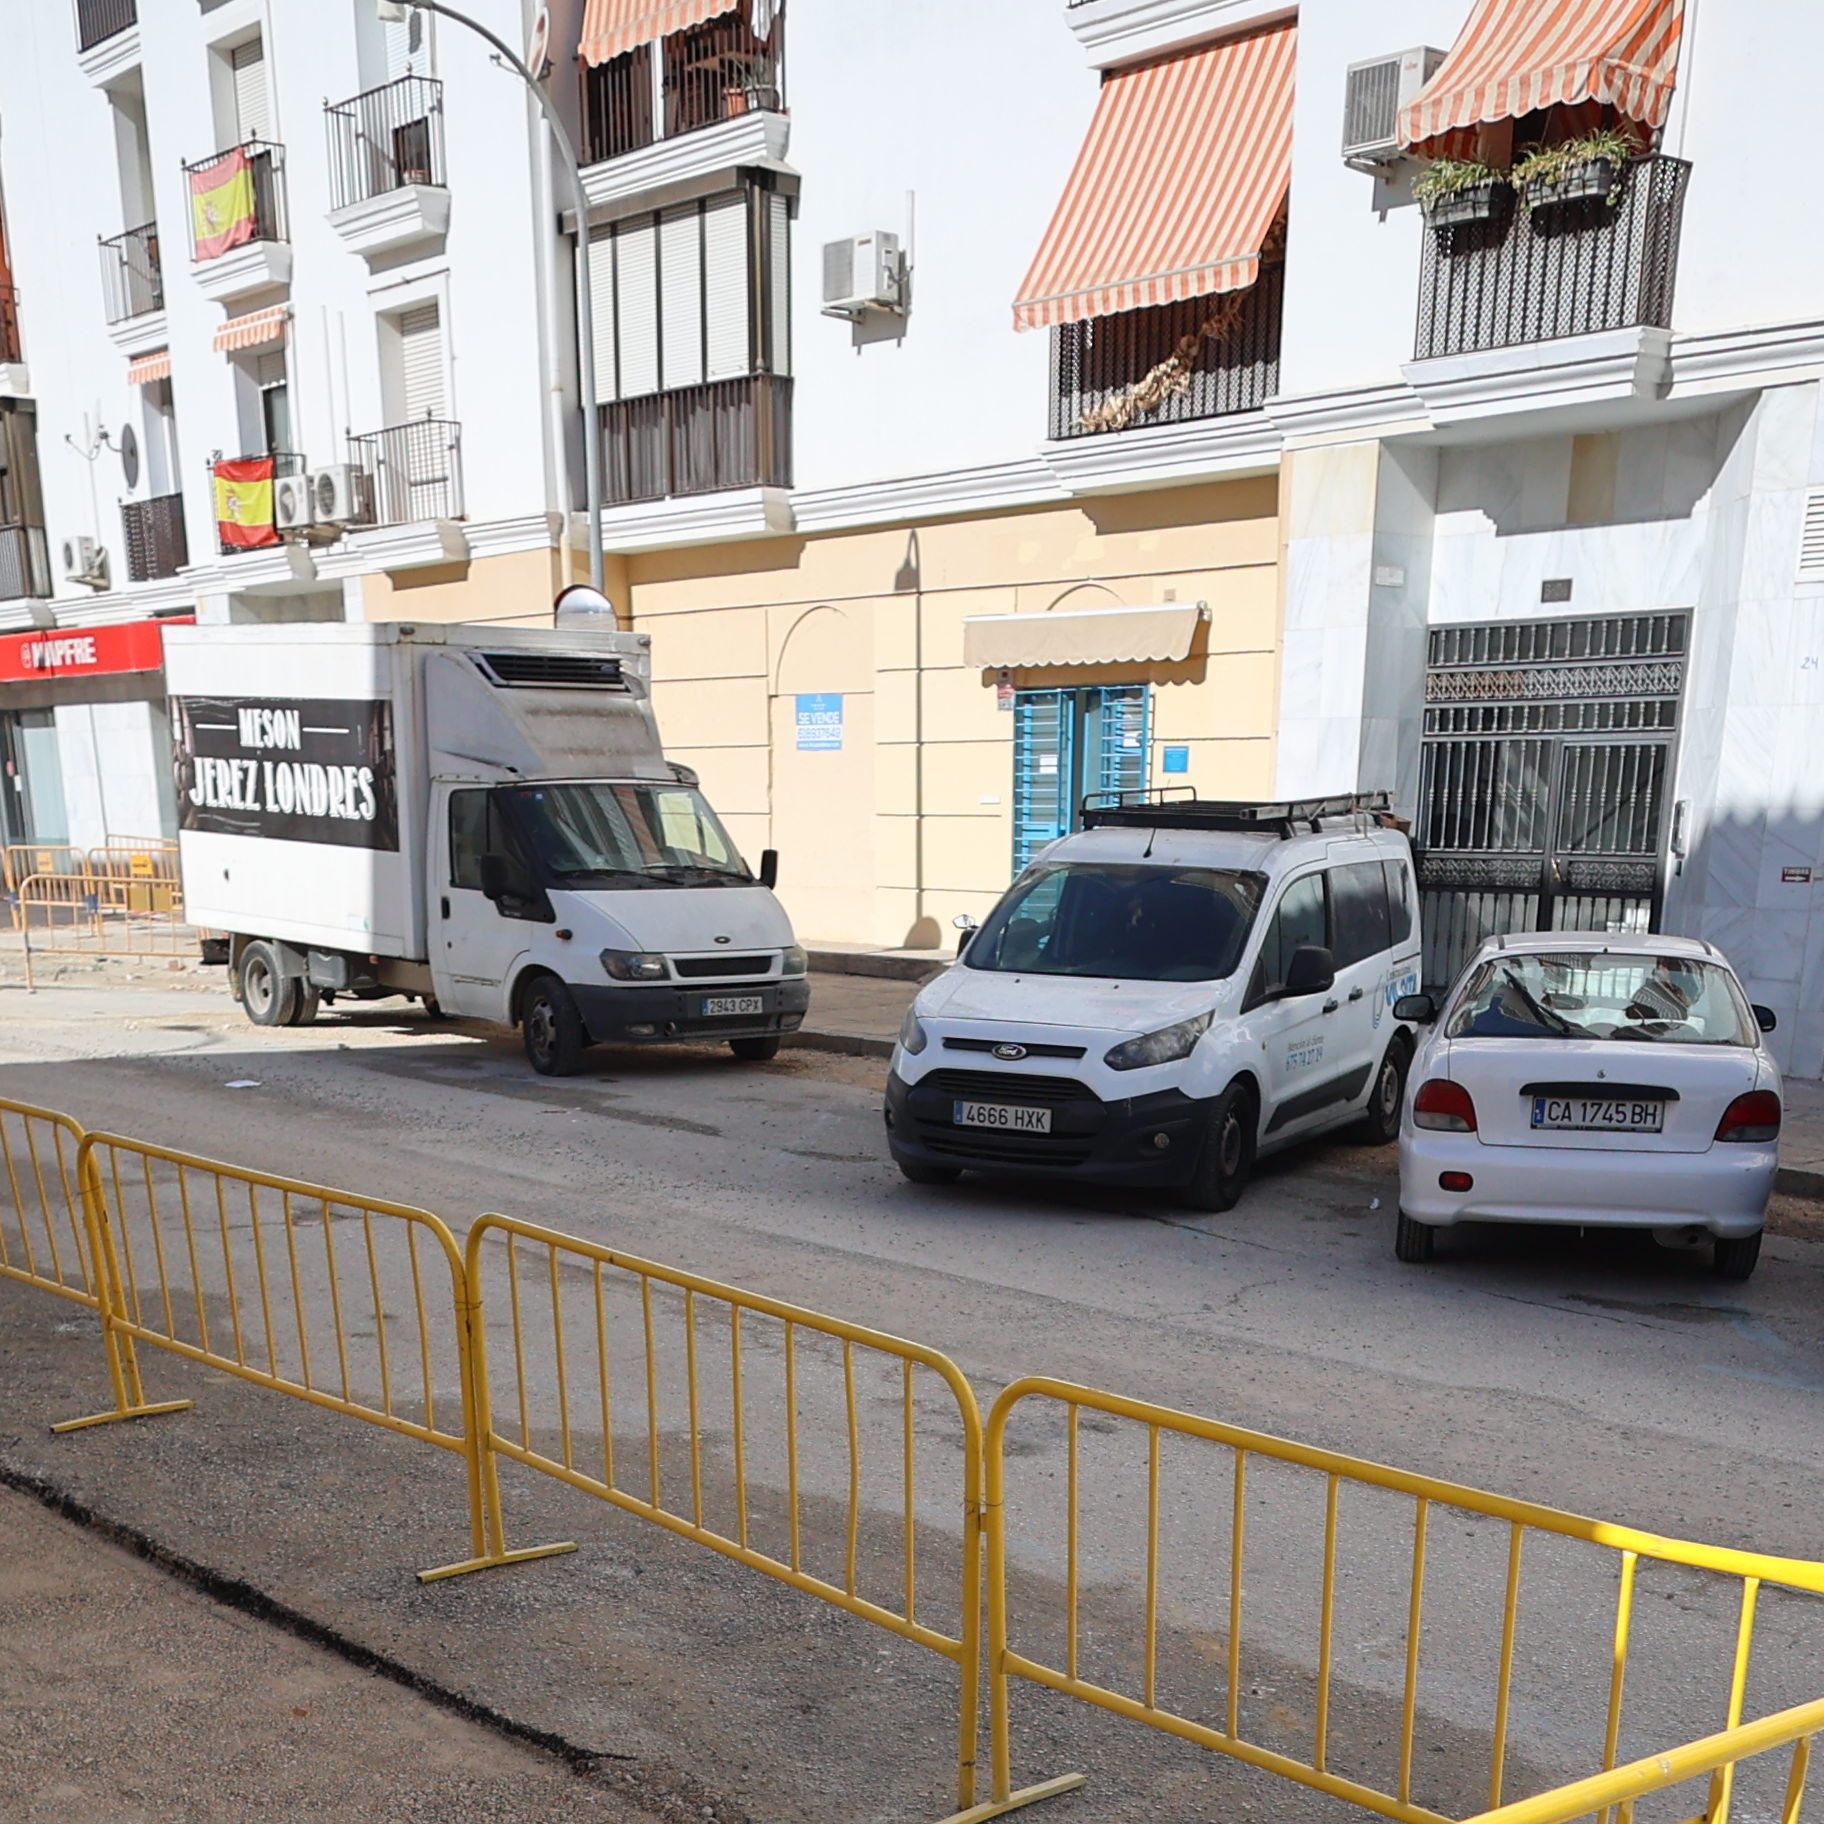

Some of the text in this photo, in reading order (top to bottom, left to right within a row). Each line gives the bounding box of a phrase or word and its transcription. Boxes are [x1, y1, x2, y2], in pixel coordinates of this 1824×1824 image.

[1801, 656, 1818, 670] 24
[237, 708, 301, 750] MESON
[798, 711, 840, 724] SE VENDE
[188, 756, 376, 820] JEREZ LONDRES
[710, 998, 760, 1014] 2943 CPX
[966, 1105, 1046, 1129] 4666 HXK
[1547, 1101, 1658, 1125] CA 1745 BH
